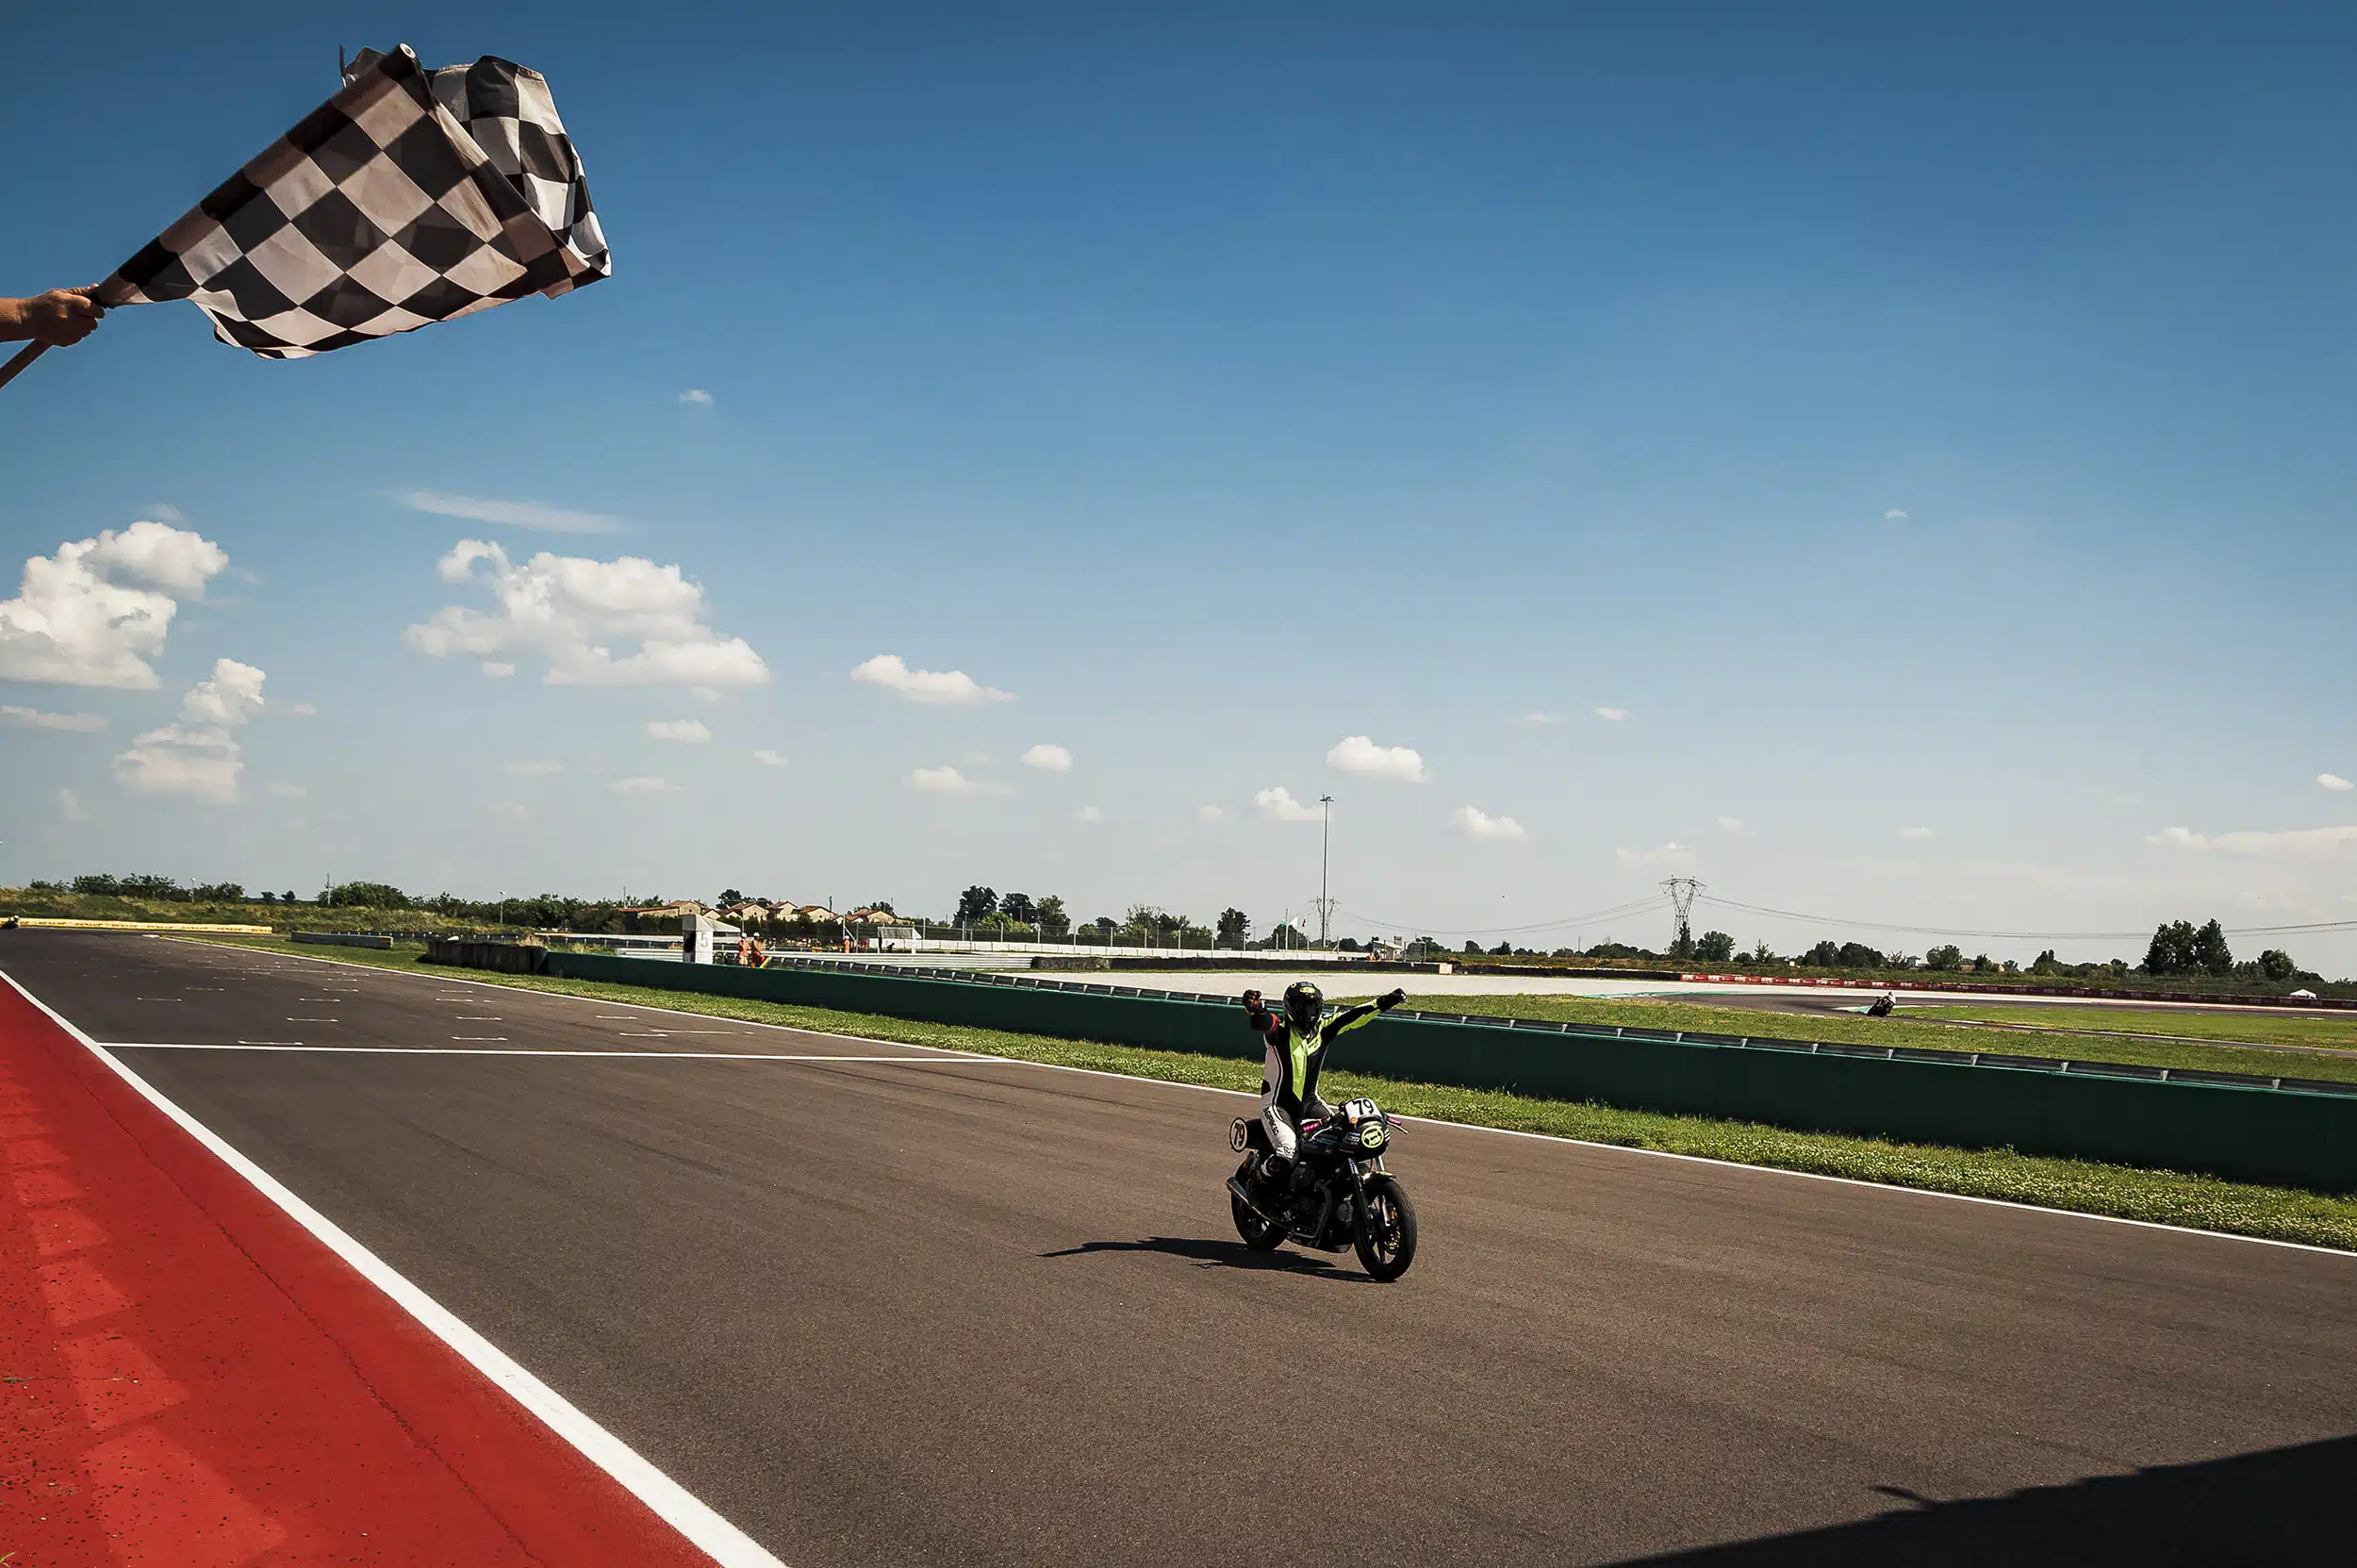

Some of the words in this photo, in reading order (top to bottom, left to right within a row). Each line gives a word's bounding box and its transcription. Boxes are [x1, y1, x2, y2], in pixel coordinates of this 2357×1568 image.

[701, 932, 708, 948] 5
[1351, 1098, 1375, 1115] 79
[1233, 1122, 1245, 1147] 79
